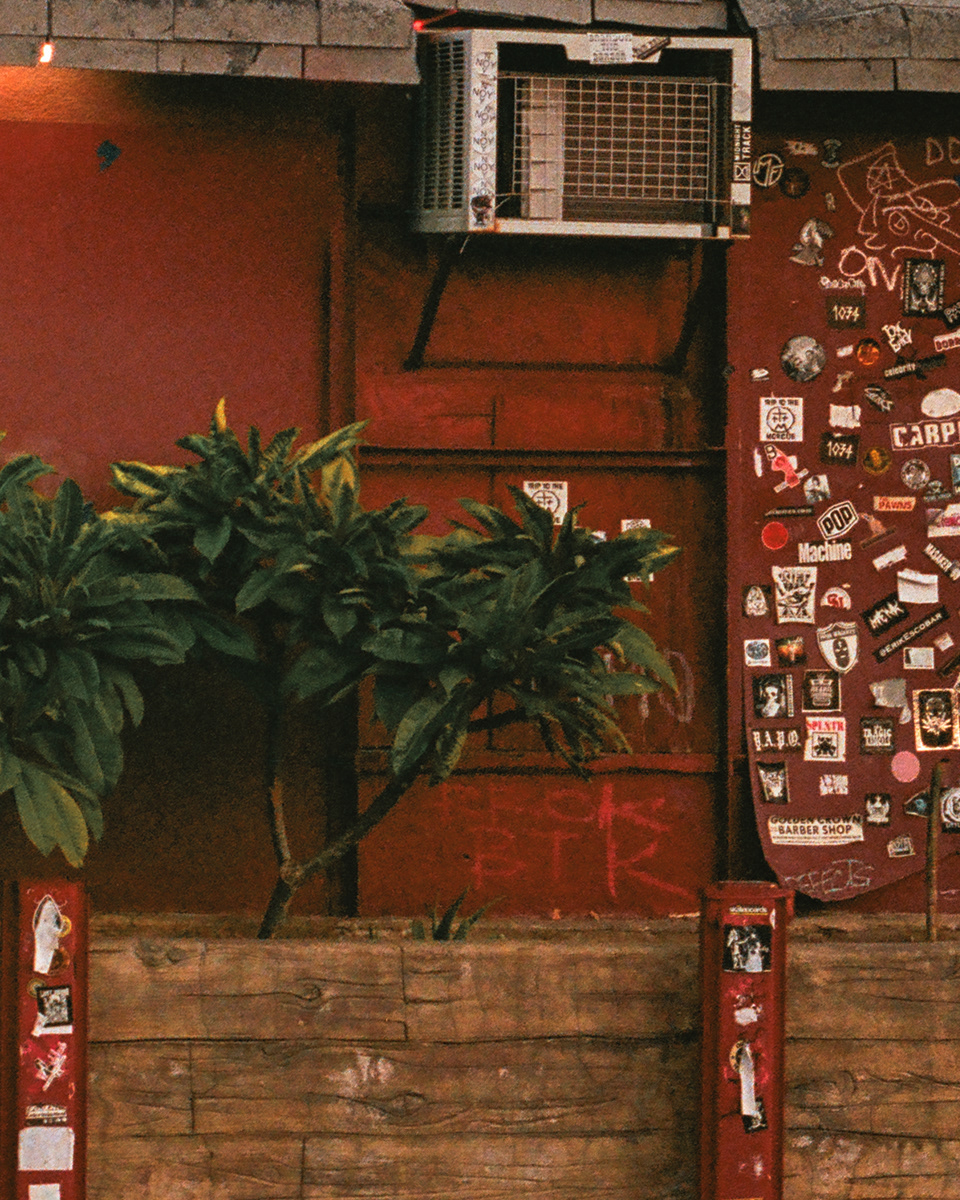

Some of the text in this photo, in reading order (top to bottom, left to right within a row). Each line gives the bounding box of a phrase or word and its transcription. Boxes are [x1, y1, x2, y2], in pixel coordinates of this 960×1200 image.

[742, 125, 751, 159] TRACK
[832, 304, 861, 322] 1034
[826, 441, 854, 458] 1034
[551, 482, 563, 490] THE
[824, 509, 854, 535] POP
[799, 541, 852, 563] Machine
[778, 823, 852, 835] BARBER SHOP
